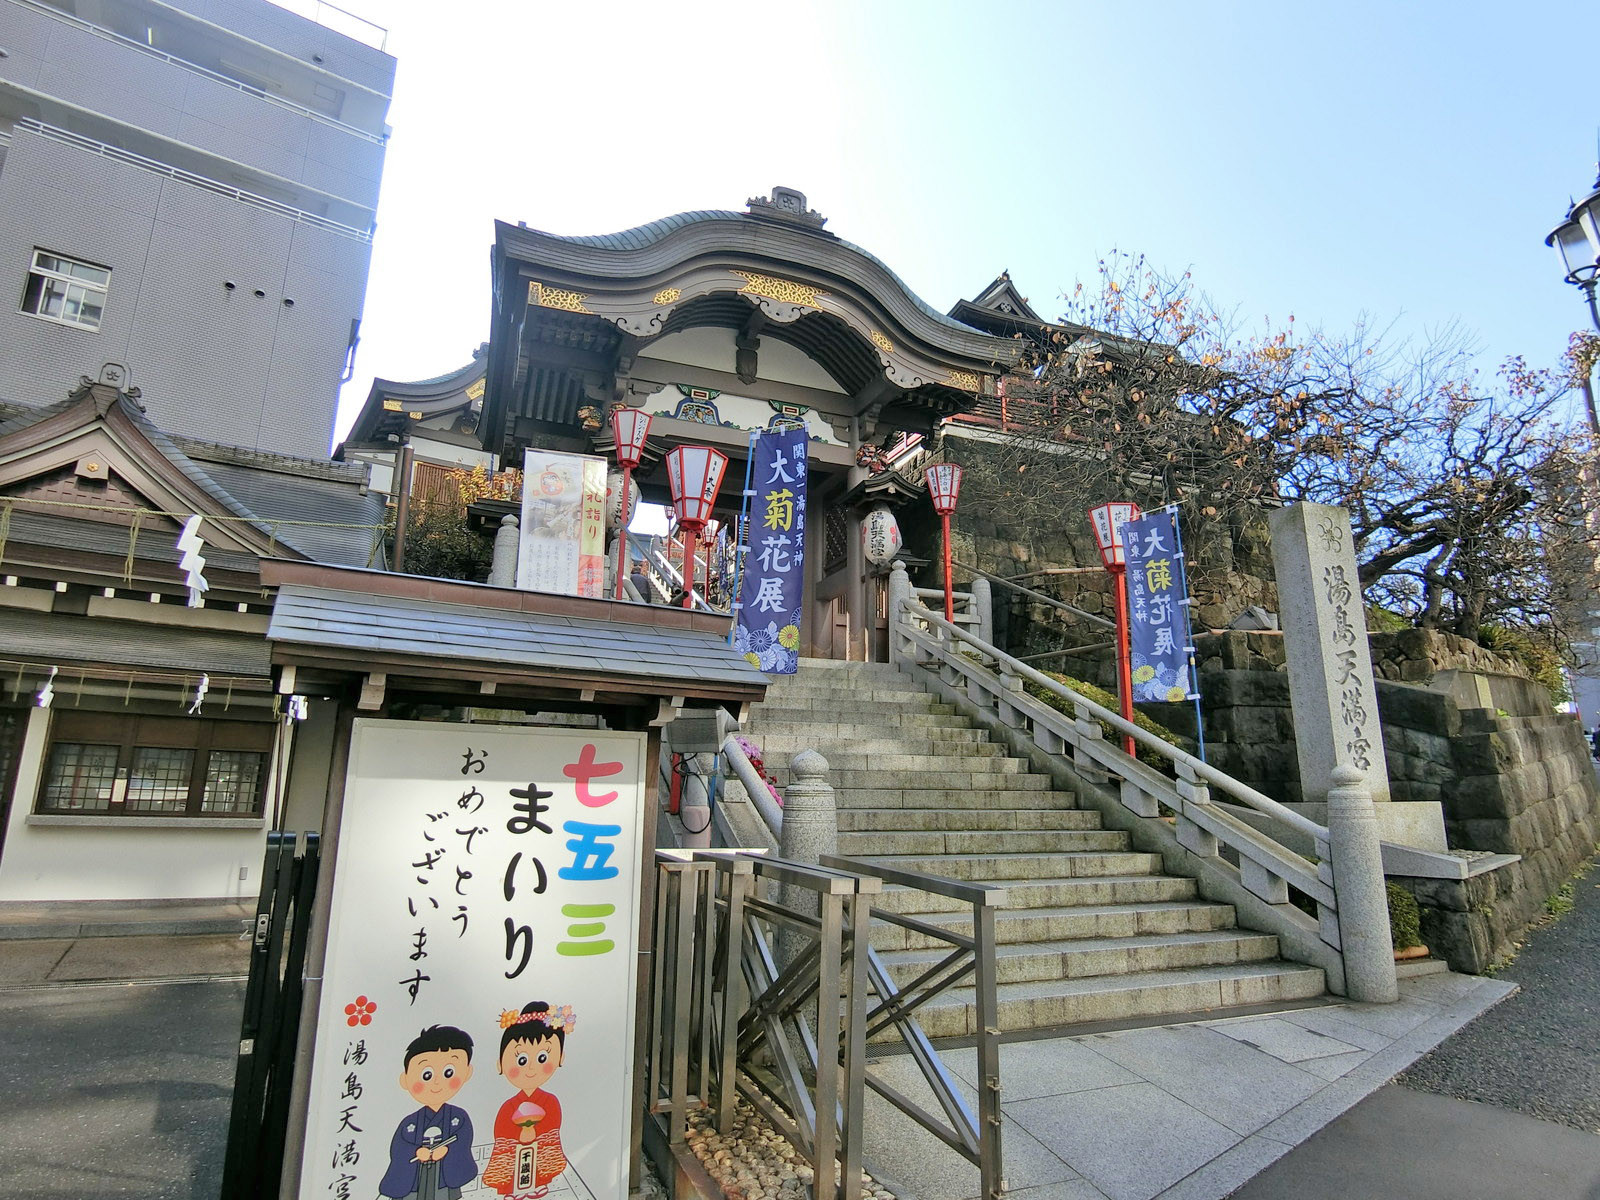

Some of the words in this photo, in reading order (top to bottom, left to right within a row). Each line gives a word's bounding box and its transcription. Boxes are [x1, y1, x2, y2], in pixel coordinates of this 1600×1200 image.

[750, 449, 796, 613] 大菊花展
[792, 442, 806, 567] 関東一湯島天神
[1097, 510, 1111, 543] 菊花展
[398, 811, 449, 1006] ございます
[452, 747, 489, 938] おめでとう
[503, 782, 554, 979] まいり
[556, 743, 624, 956] 七五三
[328, 1039, 368, 1200] 湯島天満宮
[520, 1151, 531, 1186] 千歳飴
